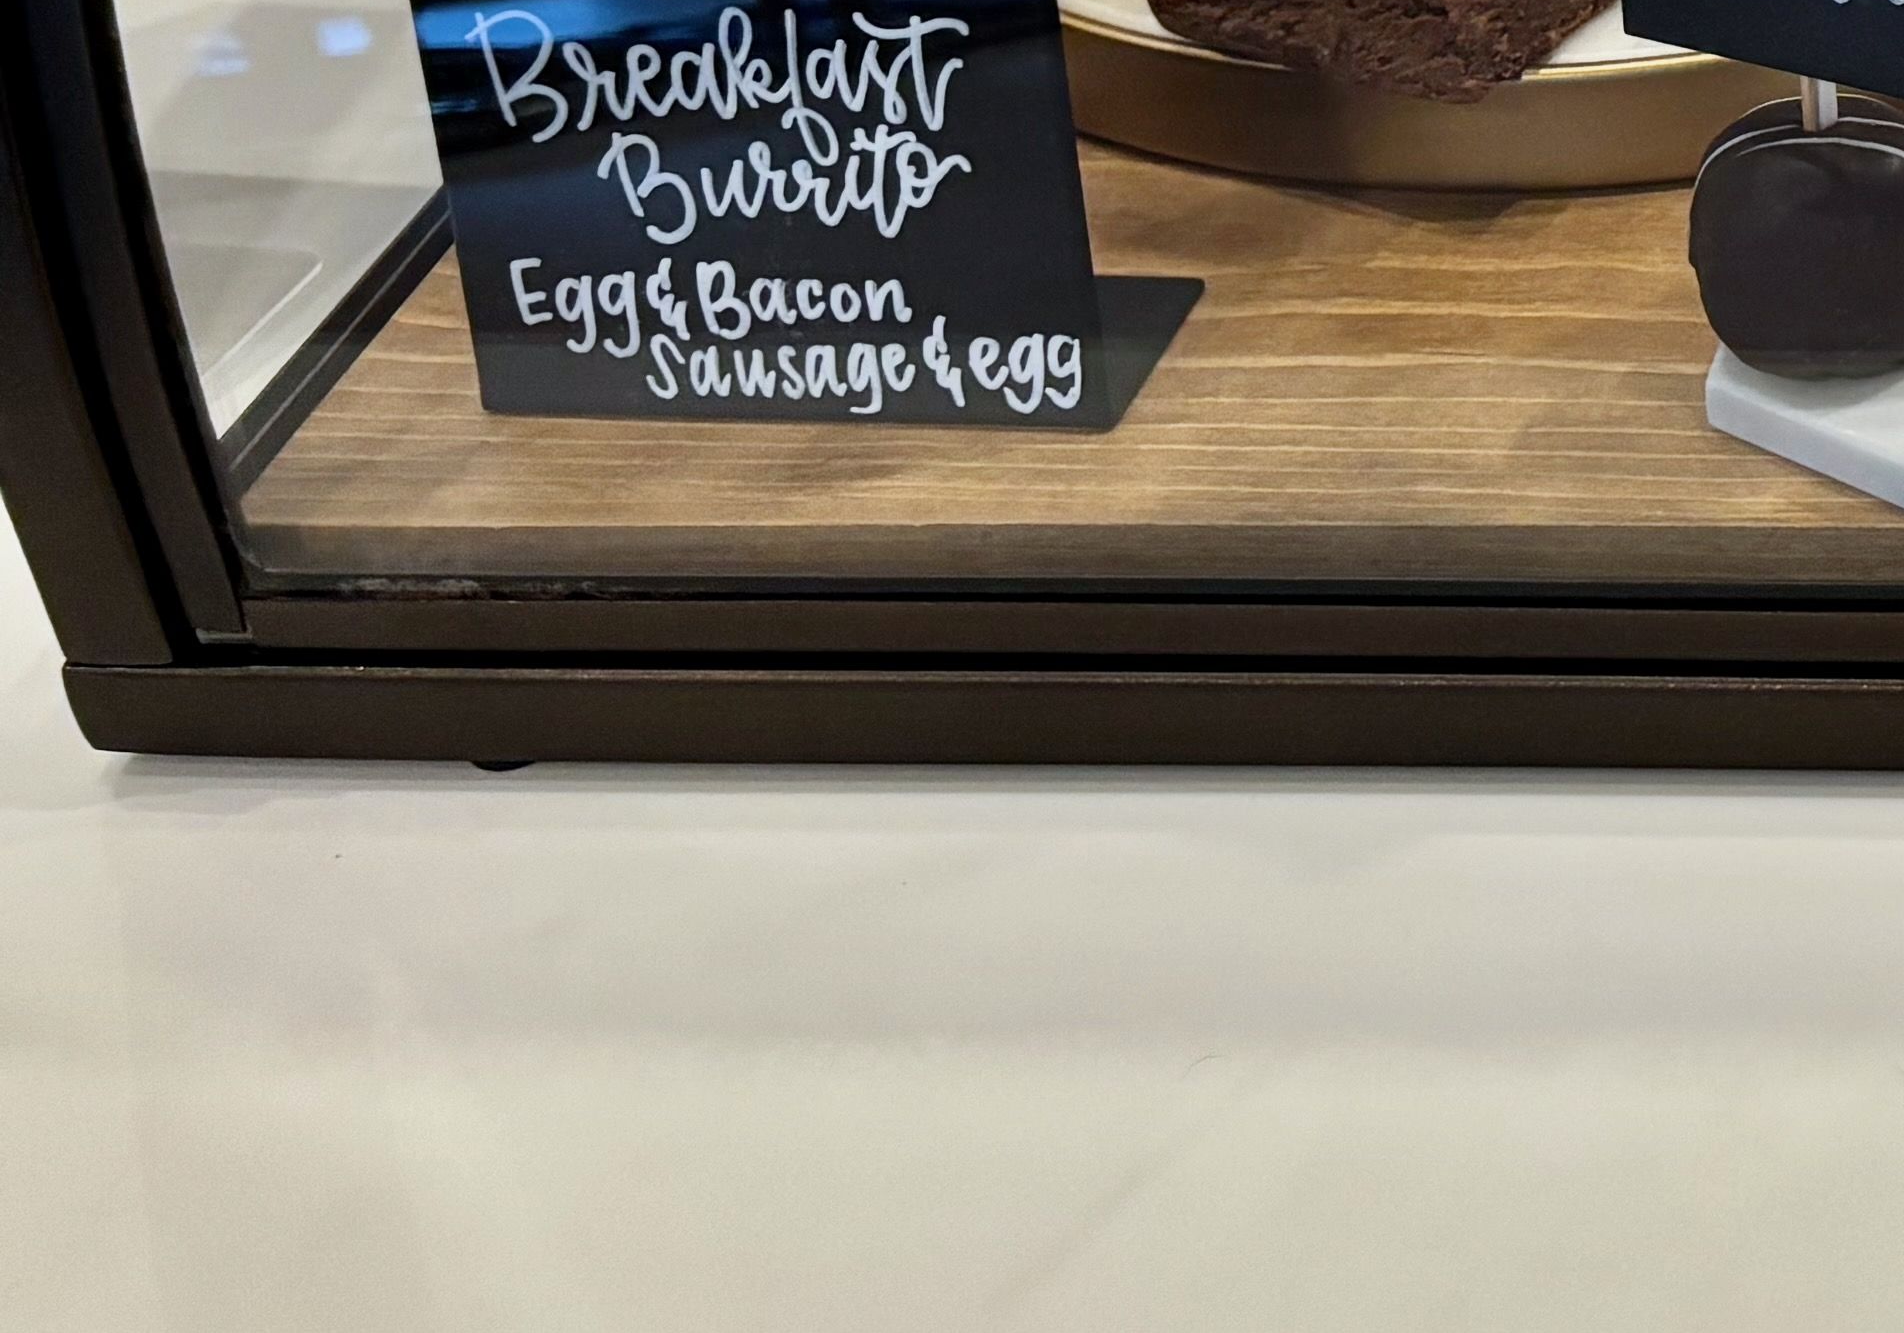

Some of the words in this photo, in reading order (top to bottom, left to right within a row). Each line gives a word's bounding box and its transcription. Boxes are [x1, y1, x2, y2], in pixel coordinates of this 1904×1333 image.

[465, 6, 970, 165] Breakfast
[596, 125, 972, 246] Burrito
[509, 257, 638, 359] Egg
[696, 259, 913, 341] Bacon
[645, 337, 915, 415] Sausage
[967, 332, 1082, 415] egg
